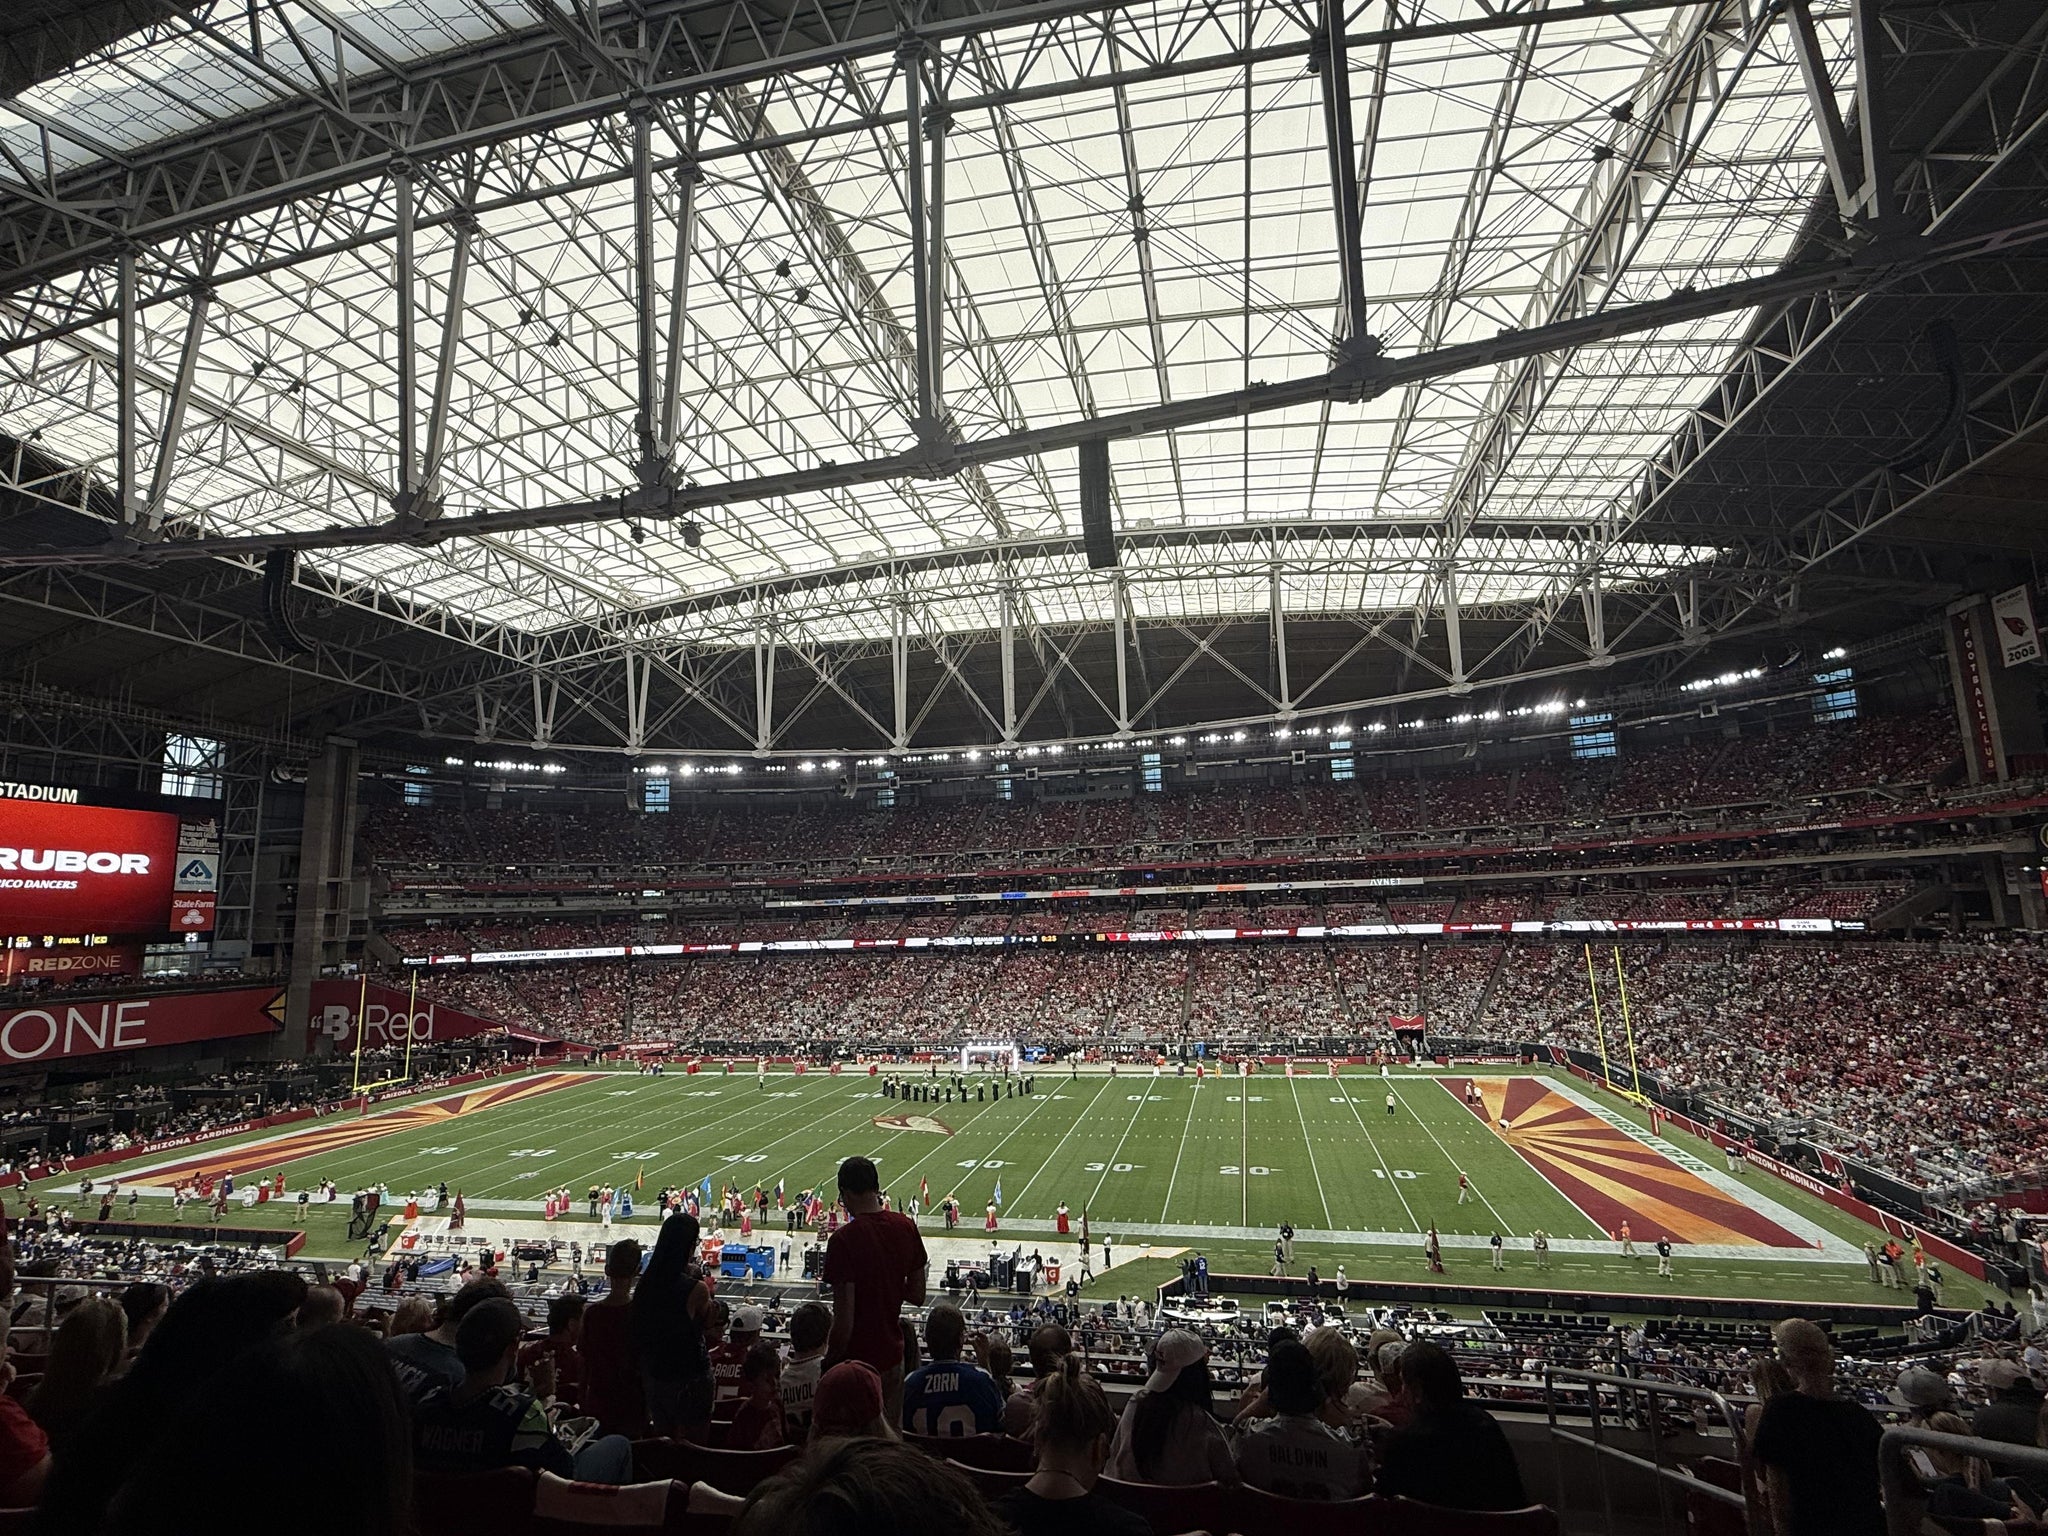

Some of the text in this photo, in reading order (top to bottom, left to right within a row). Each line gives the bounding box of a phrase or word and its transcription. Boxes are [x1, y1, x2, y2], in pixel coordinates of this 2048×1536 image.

[2008, 645, 2037, 662] 2008
[1964, 628, 1995, 769] FOOTBALL CLUB
[0, 782, 78, 803] STADIUM
[1775, 821, 1842, 833] MARSHALL GOLDBERG
[24, 880, 78, 889] DANCERS
[1370, 879, 1402, 887] AVNET
[185, 932, 198, 942] 25
[499, 951, 547, 959] O.HAMPTON
[28, 954, 122, 973] REDZONE
[364, 1003, 434, 1041] Red
[1, 1001, 150, 1060] ONE
[381, 1088, 413, 1100] ARIZONA
[141, 1122, 252, 1155] ARIZONA CARDINALS
[957, 1159, 1006, 1169] 40
[1084, 1162, 1133, 1172] 30
[1219, 1165, 1270, 1176] 20
[1371, 1168, 1417, 1179] 10
[1746, 1150, 1826, 1196] ARIZONA CARDINALS
[1048, 1269, 1057, 1279] G
[924, 1372, 959, 1394] ZORN
